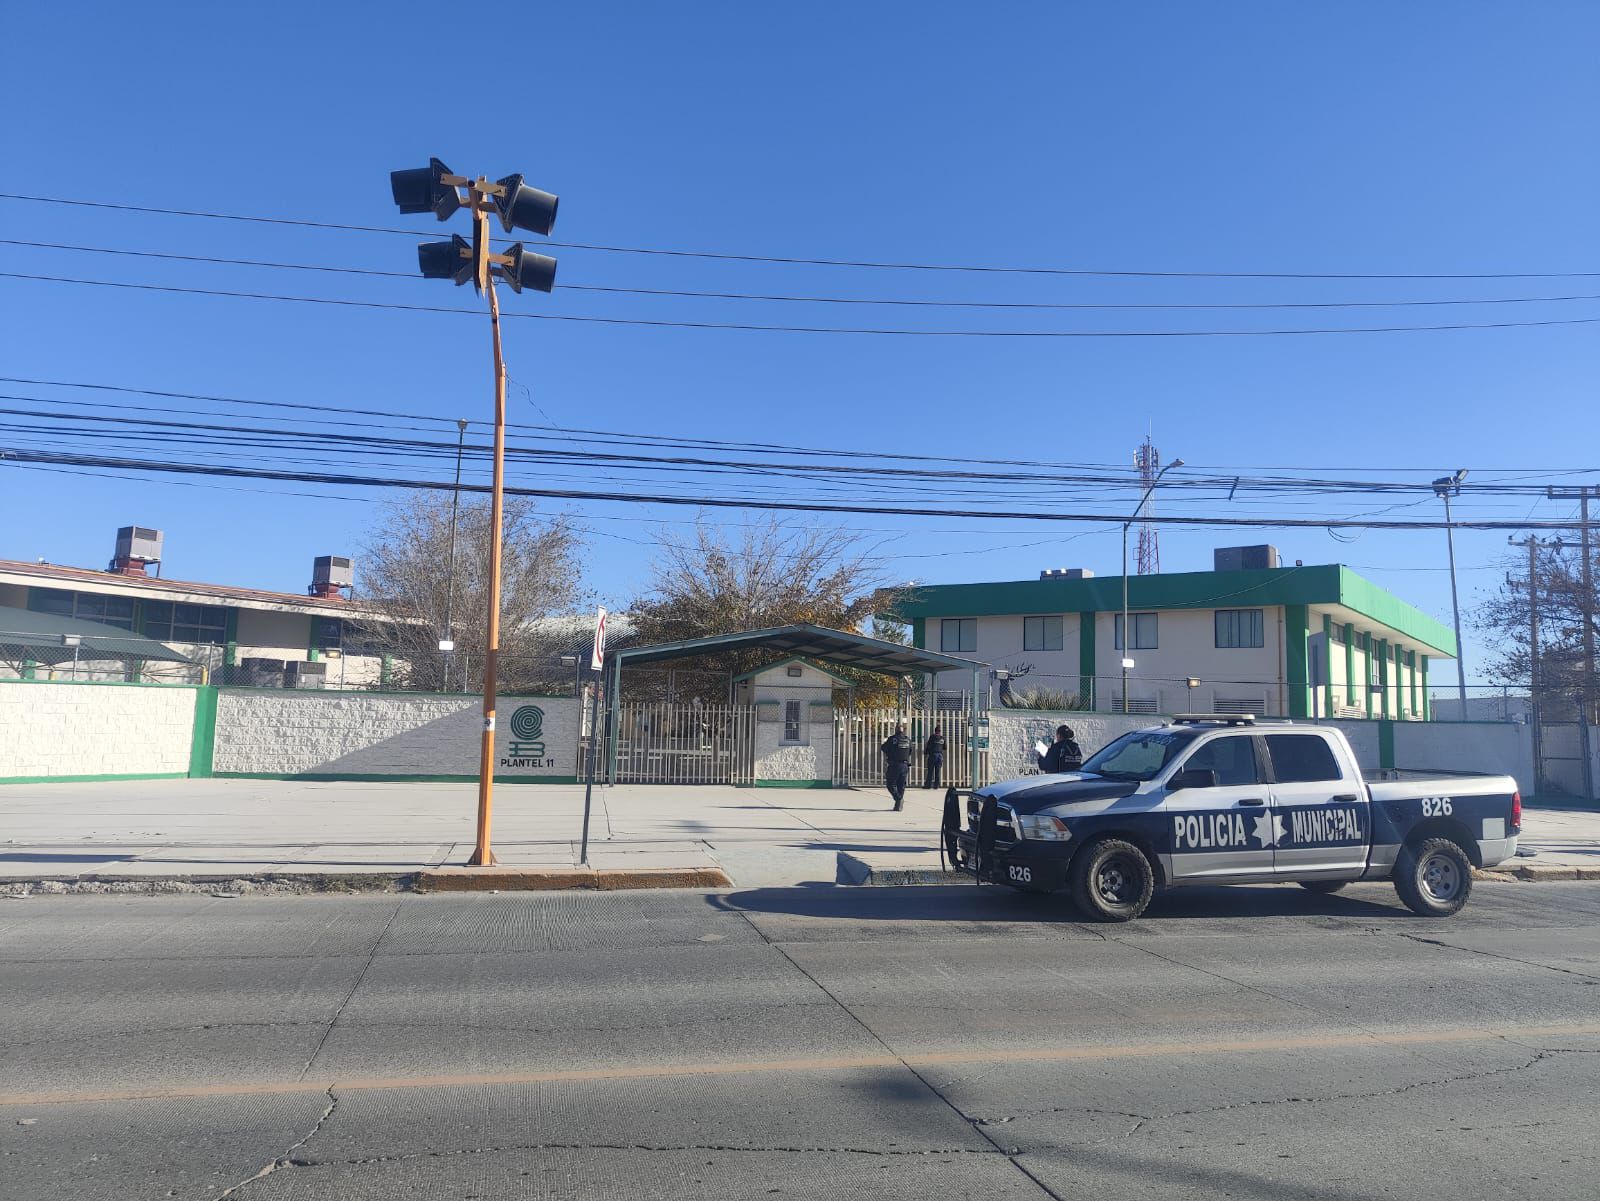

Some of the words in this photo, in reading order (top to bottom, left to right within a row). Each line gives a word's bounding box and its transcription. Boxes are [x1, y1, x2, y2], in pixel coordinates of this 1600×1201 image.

[500, 758, 543, 768] PLANTEL
[546, 758, 555, 768] 11
[1018, 768, 1039, 776] PLAN
[1421, 797, 1453, 817] 826
[1174, 814, 1247, 849] POLICIA
[1291, 808, 1362, 843] MUNICIPAL
[1008, 865, 1032, 882] 826
